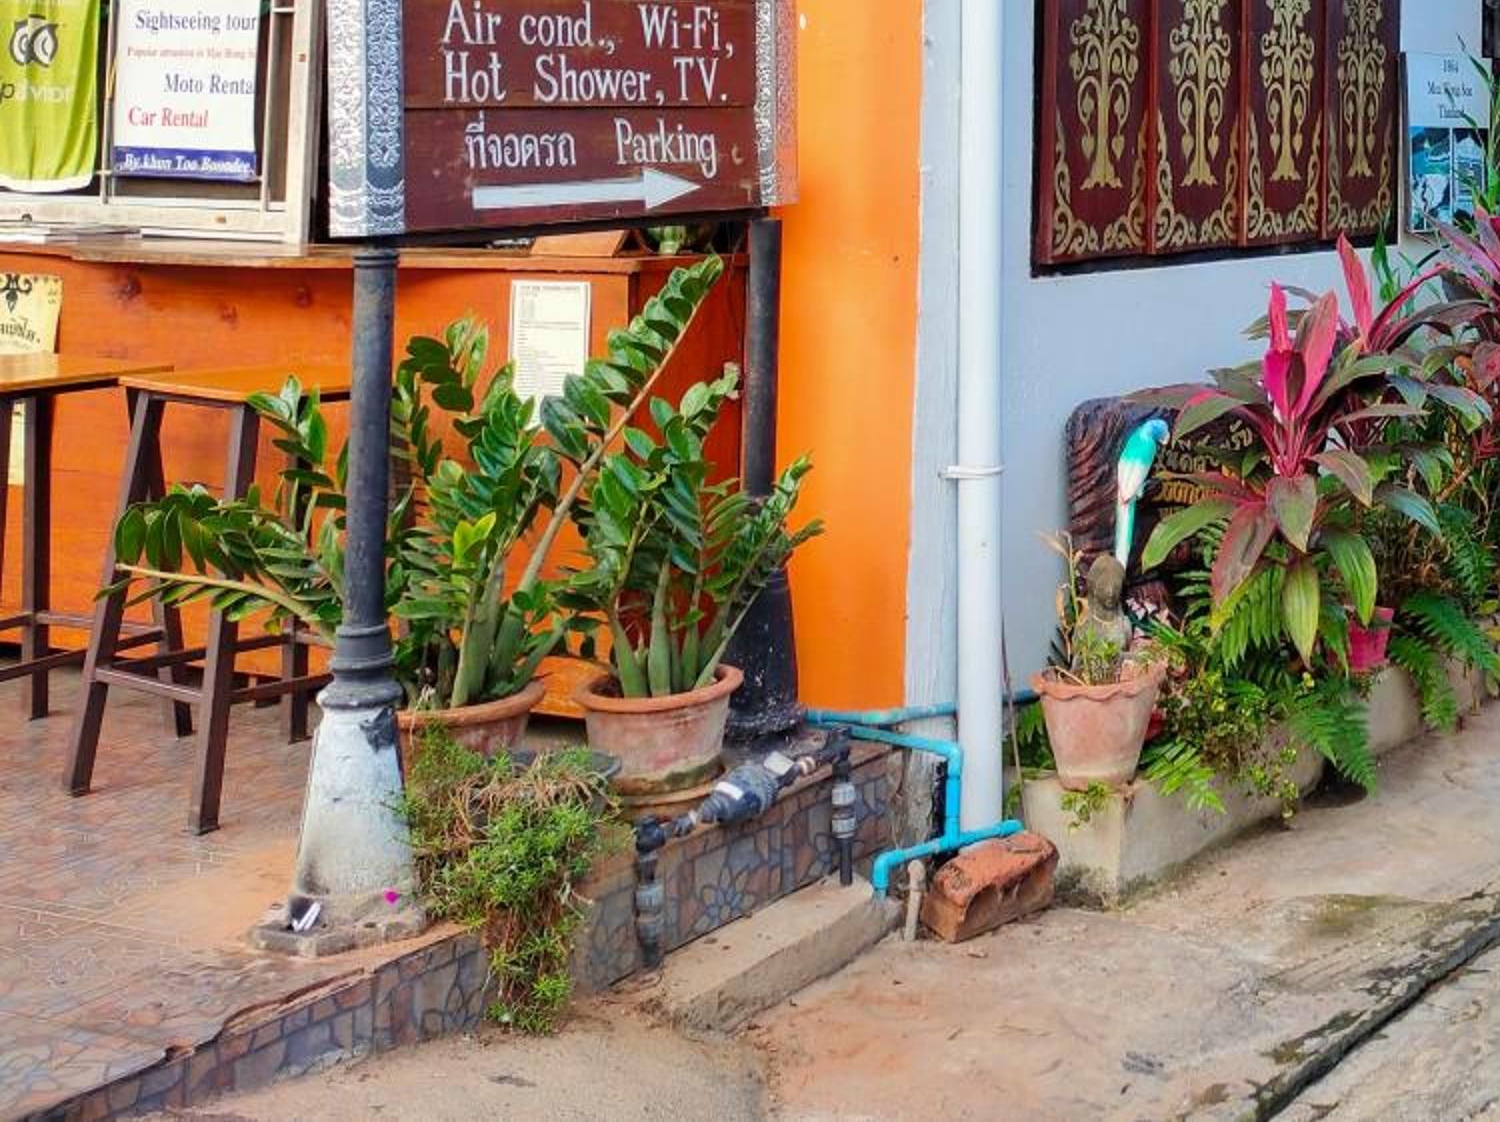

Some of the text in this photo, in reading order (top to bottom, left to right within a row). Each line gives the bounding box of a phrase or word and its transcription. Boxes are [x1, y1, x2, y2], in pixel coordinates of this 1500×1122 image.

[135, 9, 221, 34] Sightseeing
[637, 3, 734, 59] Wi-Fi,
[164, 73, 256, 95] Moto Renta
[443, 50, 729, 107] Hot Shower, TV.
[128, 106, 209, 128] Car Rental
[464, 109, 717, 179] ที่จอดรถ Parking
